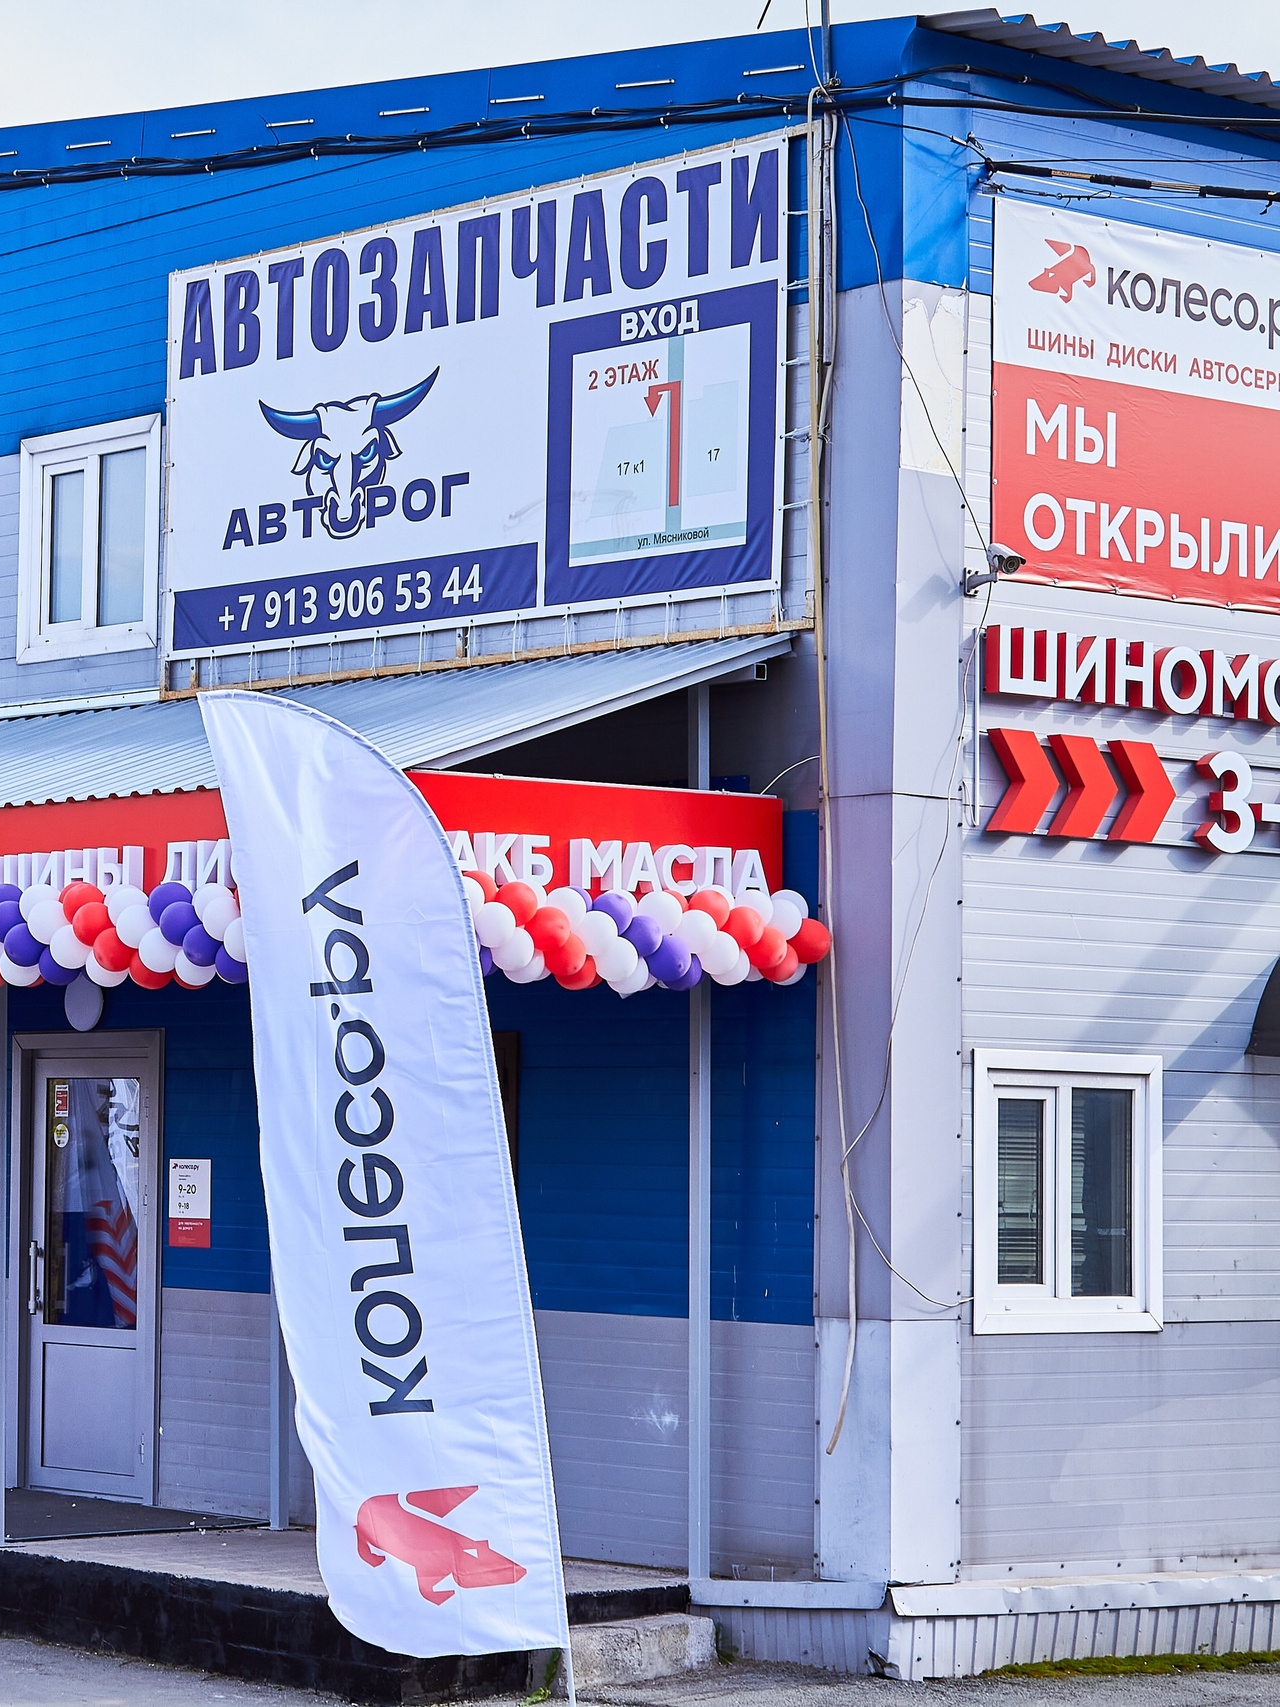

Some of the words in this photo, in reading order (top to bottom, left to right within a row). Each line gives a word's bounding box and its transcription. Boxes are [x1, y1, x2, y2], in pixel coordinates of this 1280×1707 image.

[179, 149, 779, 380] АВТОЗАПЧАСТИ
[620, 299, 700, 342] ВХОД
[588, 370, 598, 391] 2
[604, 359, 660, 388] ЭТАЖ
[1027, 328, 1094, 359] ШИНЫ
[1107, 342, 1177, 375] ДИСКИ
[1189, 357, 1280, 392] АВТОСЕР
[707, 448, 720, 462] 17
[1026, 398, 1117, 468] МЫ
[617, 462, 630, 476] 17
[633, 460, 645, 474] к1
[222, 471, 470, 550] АВТОРОГ
[637, 538, 651, 551] ул.
[653, 526, 710, 545] Мясниковой
[1023, 492, 1280, 583] ОТКРЫЛИ
[219, 593, 256, 632] +7
[264, 585, 318, 629] 913
[329, 576, 384, 622] 906
[395, 570, 432, 612] 53
[442, 563, 483, 606] 44
[569, 838, 770, 897] МАСЛА
[302, 860, 434, 1416] колесо.ру
[178, 1184, 197, 1194] 9-20
